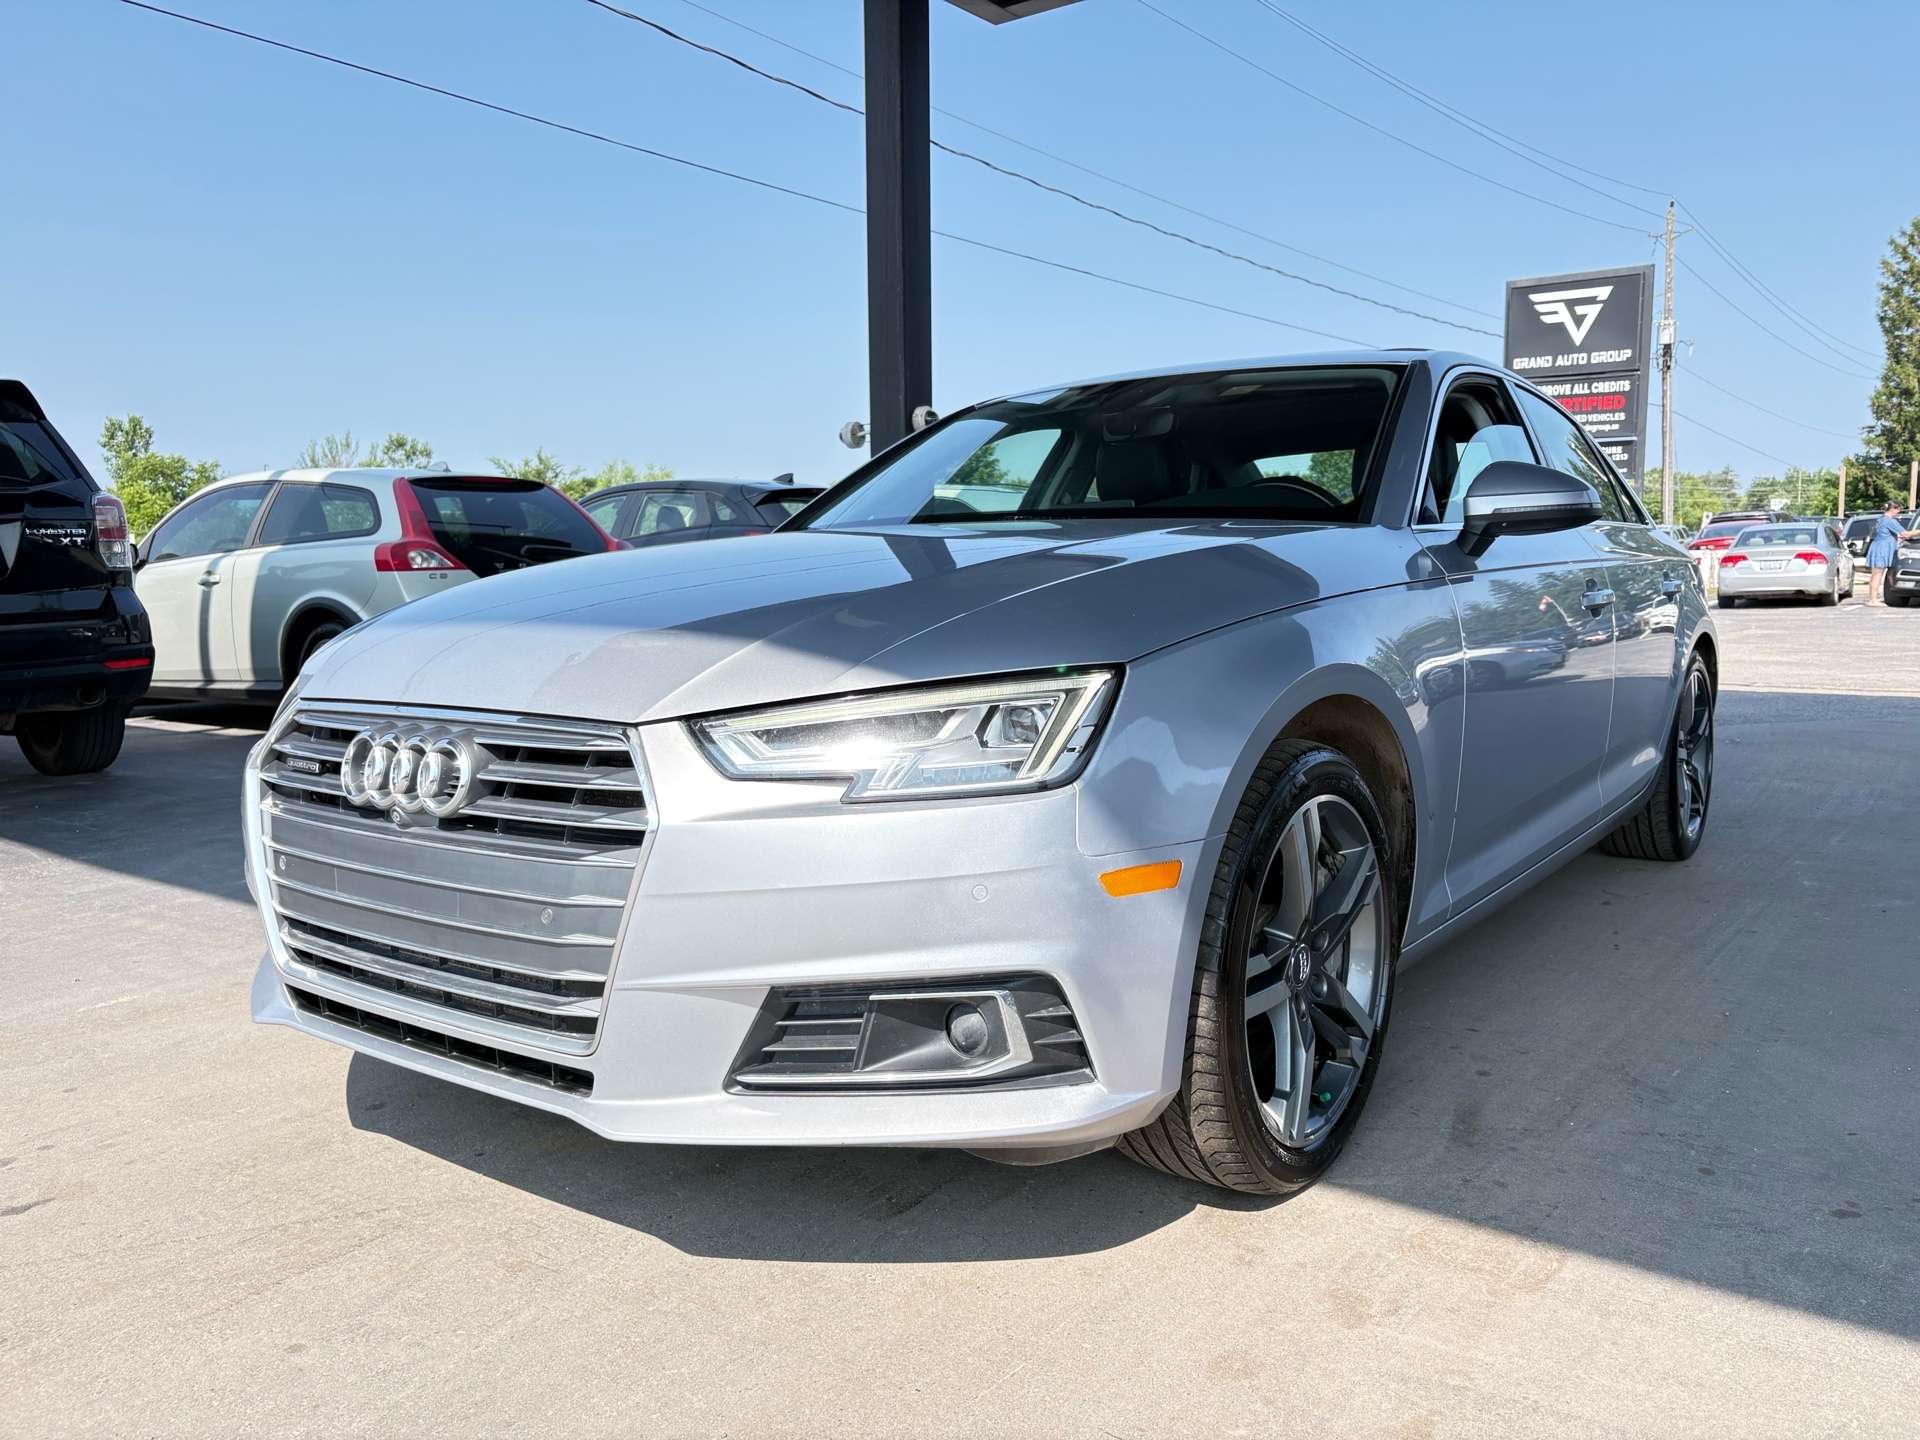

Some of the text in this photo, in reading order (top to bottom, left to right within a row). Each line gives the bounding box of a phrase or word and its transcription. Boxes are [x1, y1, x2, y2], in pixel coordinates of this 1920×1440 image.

[1513, 349, 1632, 370] GRAND AUTO GROUP
[1572, 383, 1590, 395] ALL
[1591, 380, 1631, 393] CREDITS
[1588, 412, 1626, 421] VEHICLES
[59, 537, 85, 545] XT
